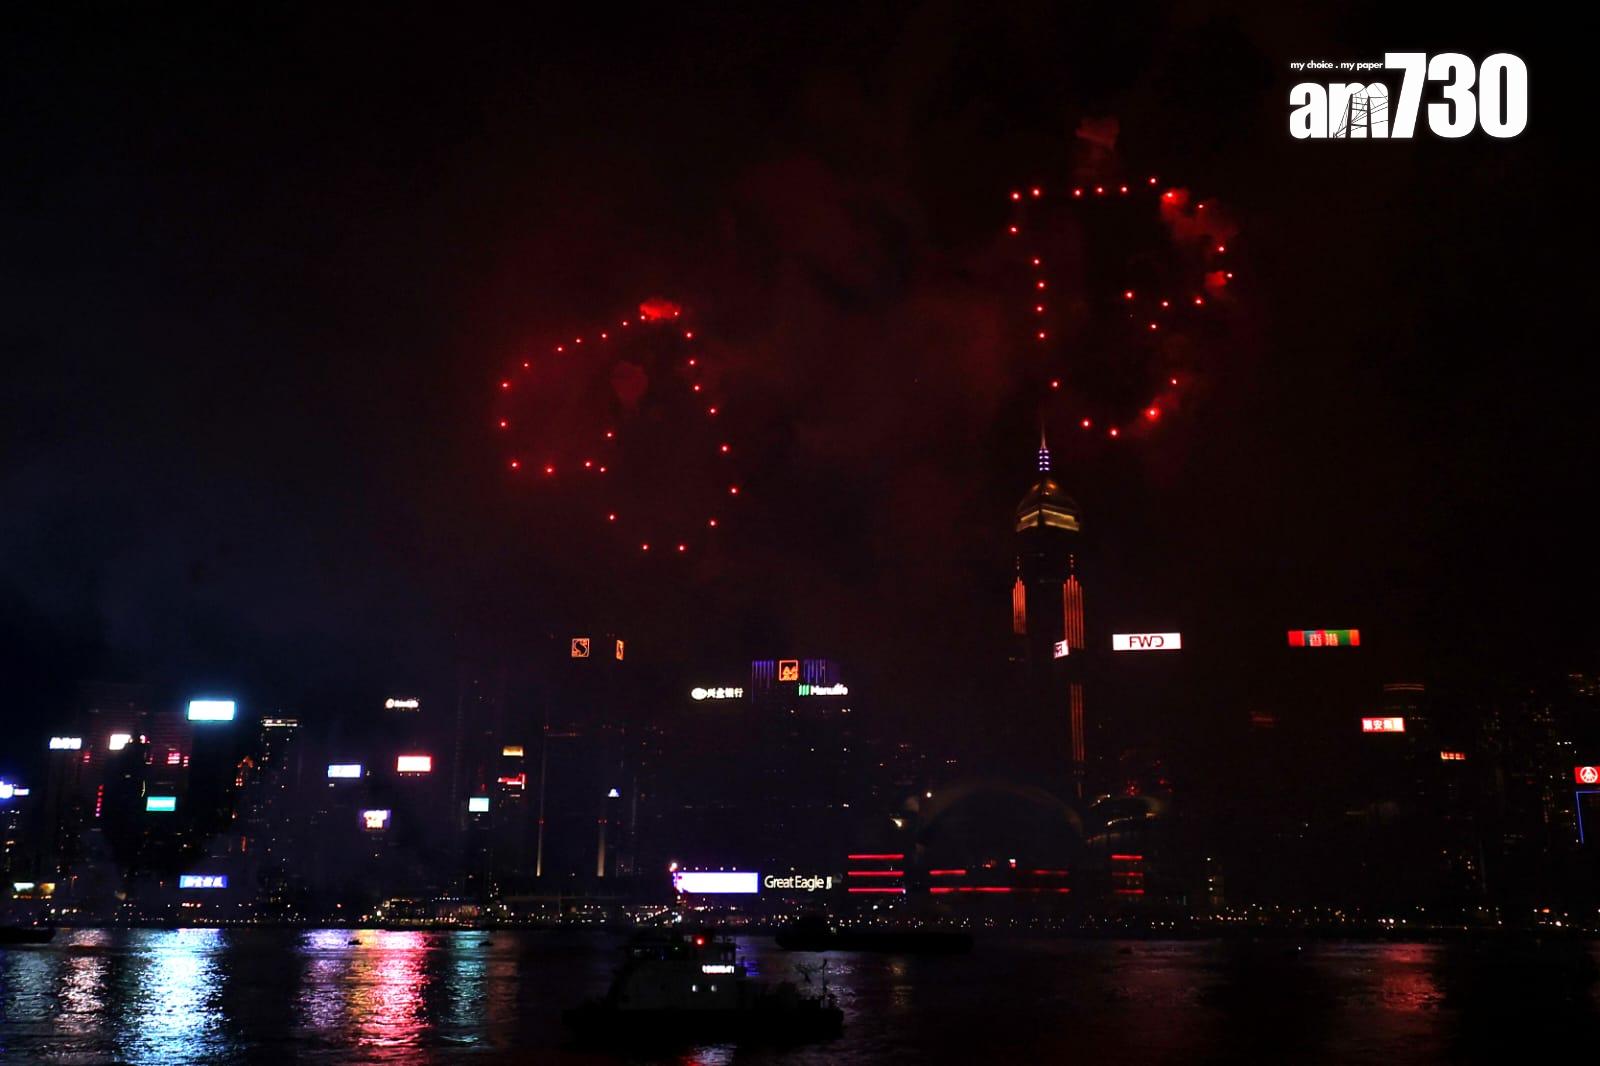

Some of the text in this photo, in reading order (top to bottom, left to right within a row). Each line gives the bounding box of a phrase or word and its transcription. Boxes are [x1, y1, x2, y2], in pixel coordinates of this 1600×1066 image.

[1129, 636, 1165, 648] FWD
[764, 875, 825, 892] Great Eagle
